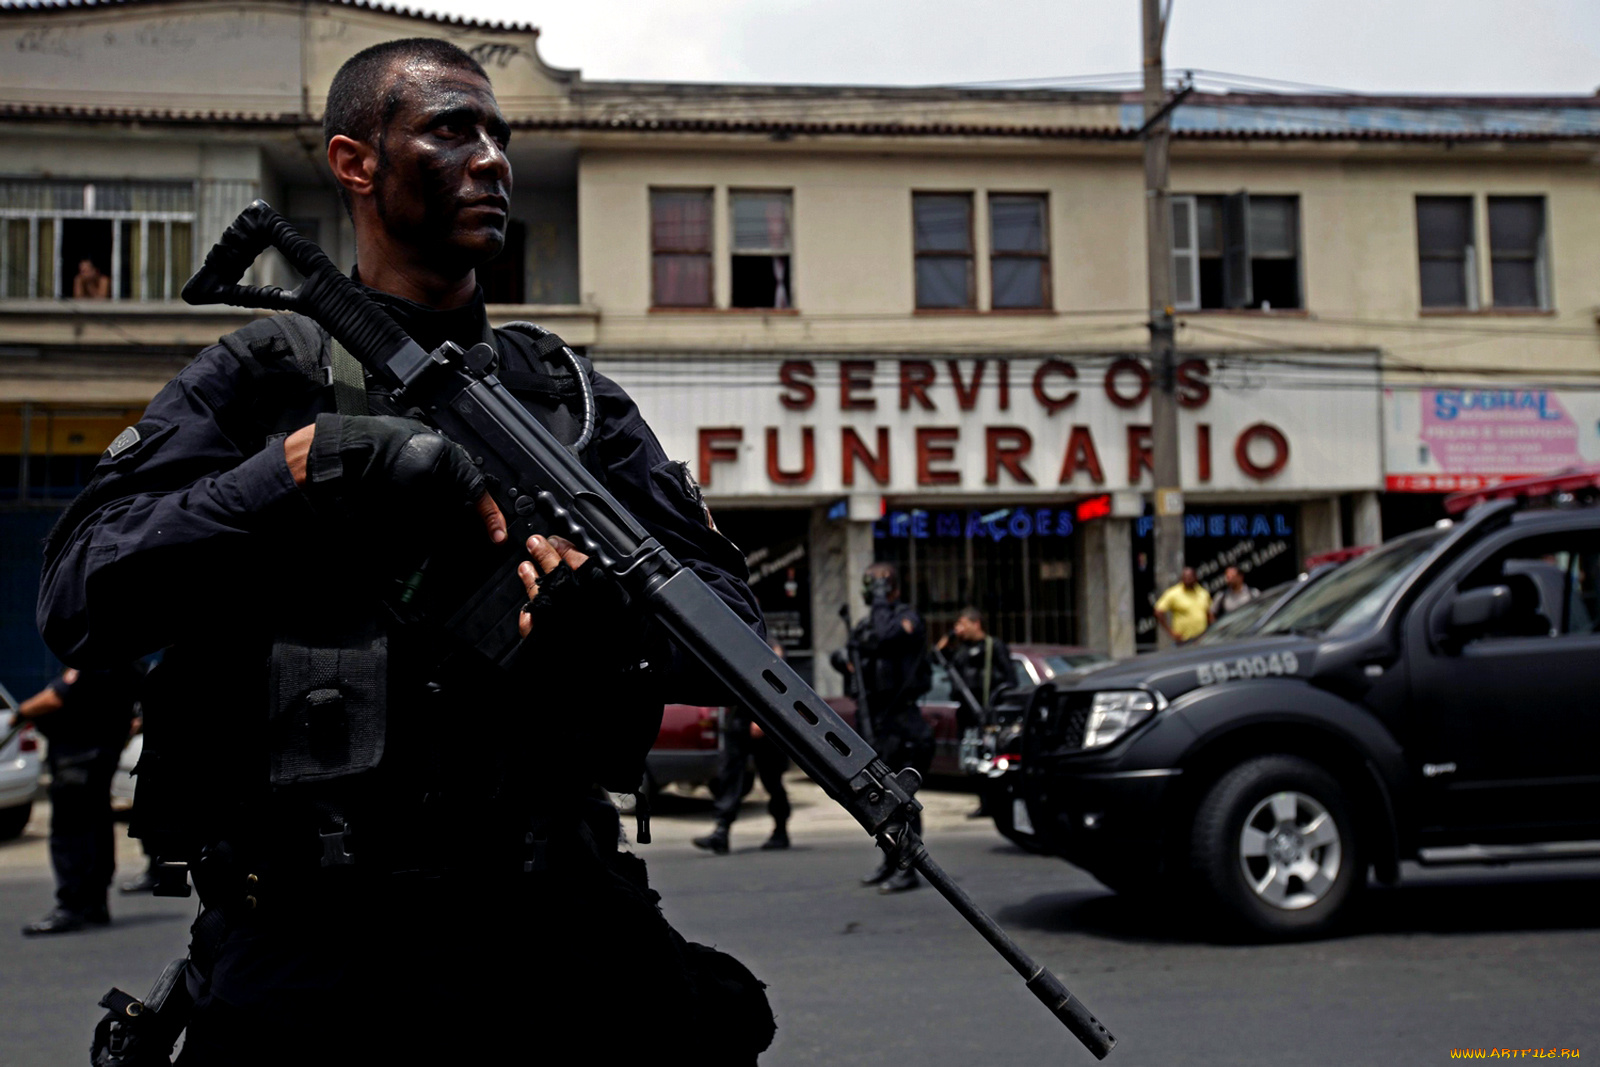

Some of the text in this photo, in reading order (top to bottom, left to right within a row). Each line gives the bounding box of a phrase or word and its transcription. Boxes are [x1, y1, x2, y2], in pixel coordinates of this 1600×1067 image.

[779, 358, 1210, 417] SERVIÇOS
[698, 422, 1289, 487] FUNERARIO
[1136, 513, 1292, 537] FNERAL
